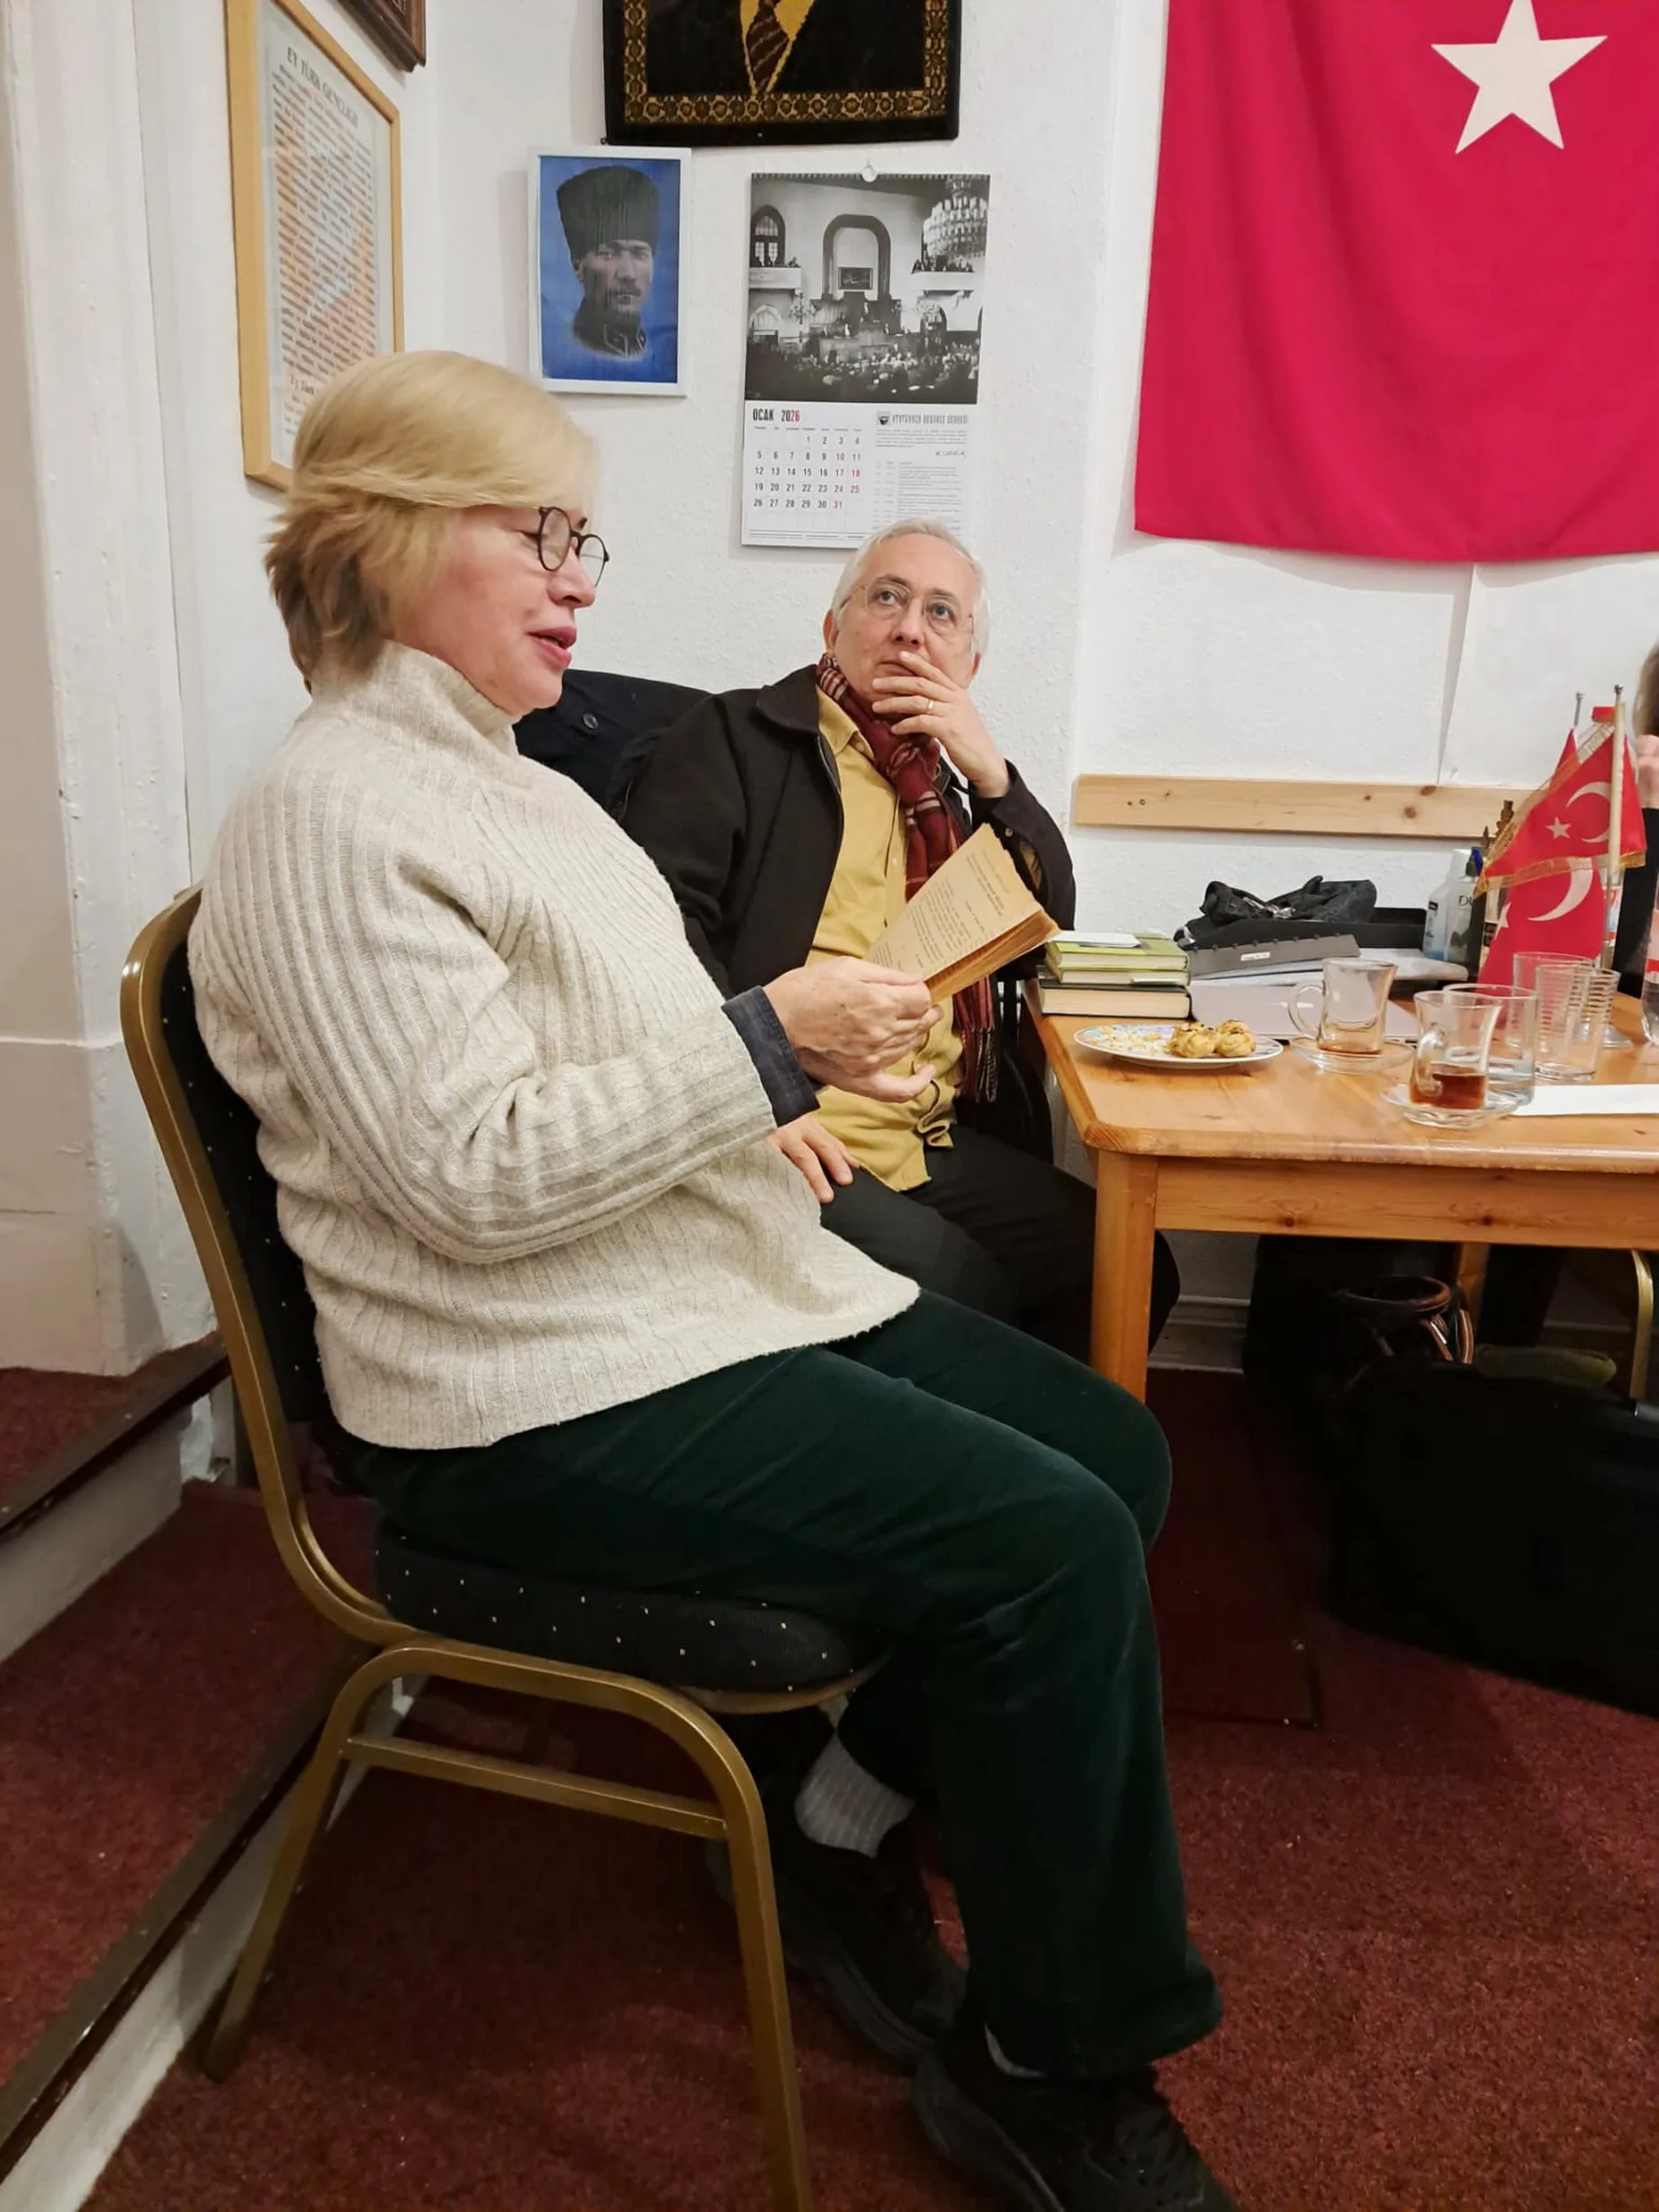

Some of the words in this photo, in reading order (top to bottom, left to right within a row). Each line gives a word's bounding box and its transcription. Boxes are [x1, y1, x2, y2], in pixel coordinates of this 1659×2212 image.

[753, 409, 773, 421] OCAK
[781, 409, 799, 421] 2026
[836, 453, 844, 461] 10
[755, 467, 763, 475] 12
[771, 467, 780, 475] 13
[804, 468, 811, 476] 15
[771, 483, 779, 491] 20
[802, 484, 811, 492] 22
[851, 485, 860, 493] 25
[753, 499, 762, 507] 26
[770, 499, 778, 507] 27
[786, 499, 794, 508] 28
[817, 500, 826, 508] 30
[834, 500, 842, 508] 31
